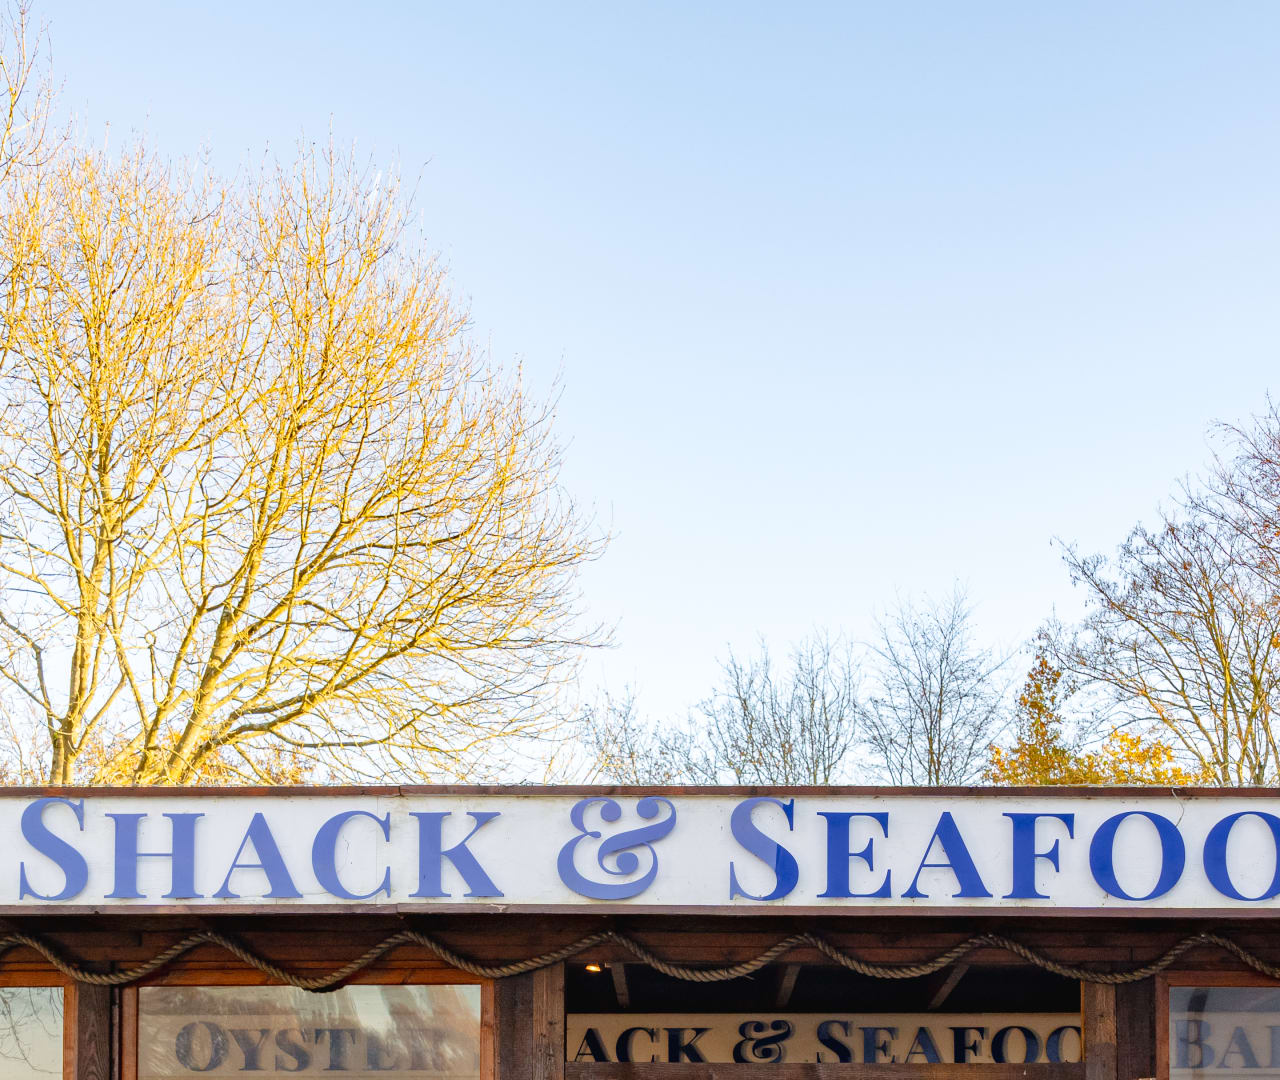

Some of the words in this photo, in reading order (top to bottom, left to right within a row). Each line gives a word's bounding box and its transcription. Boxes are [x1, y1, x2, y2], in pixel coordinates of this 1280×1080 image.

[19, 797, 504, 901] SHACK
[557, 796, 677, 900] &
[175, 1021, 454, 1072] OYSTER
[733, 1019, 792, 1063] &
